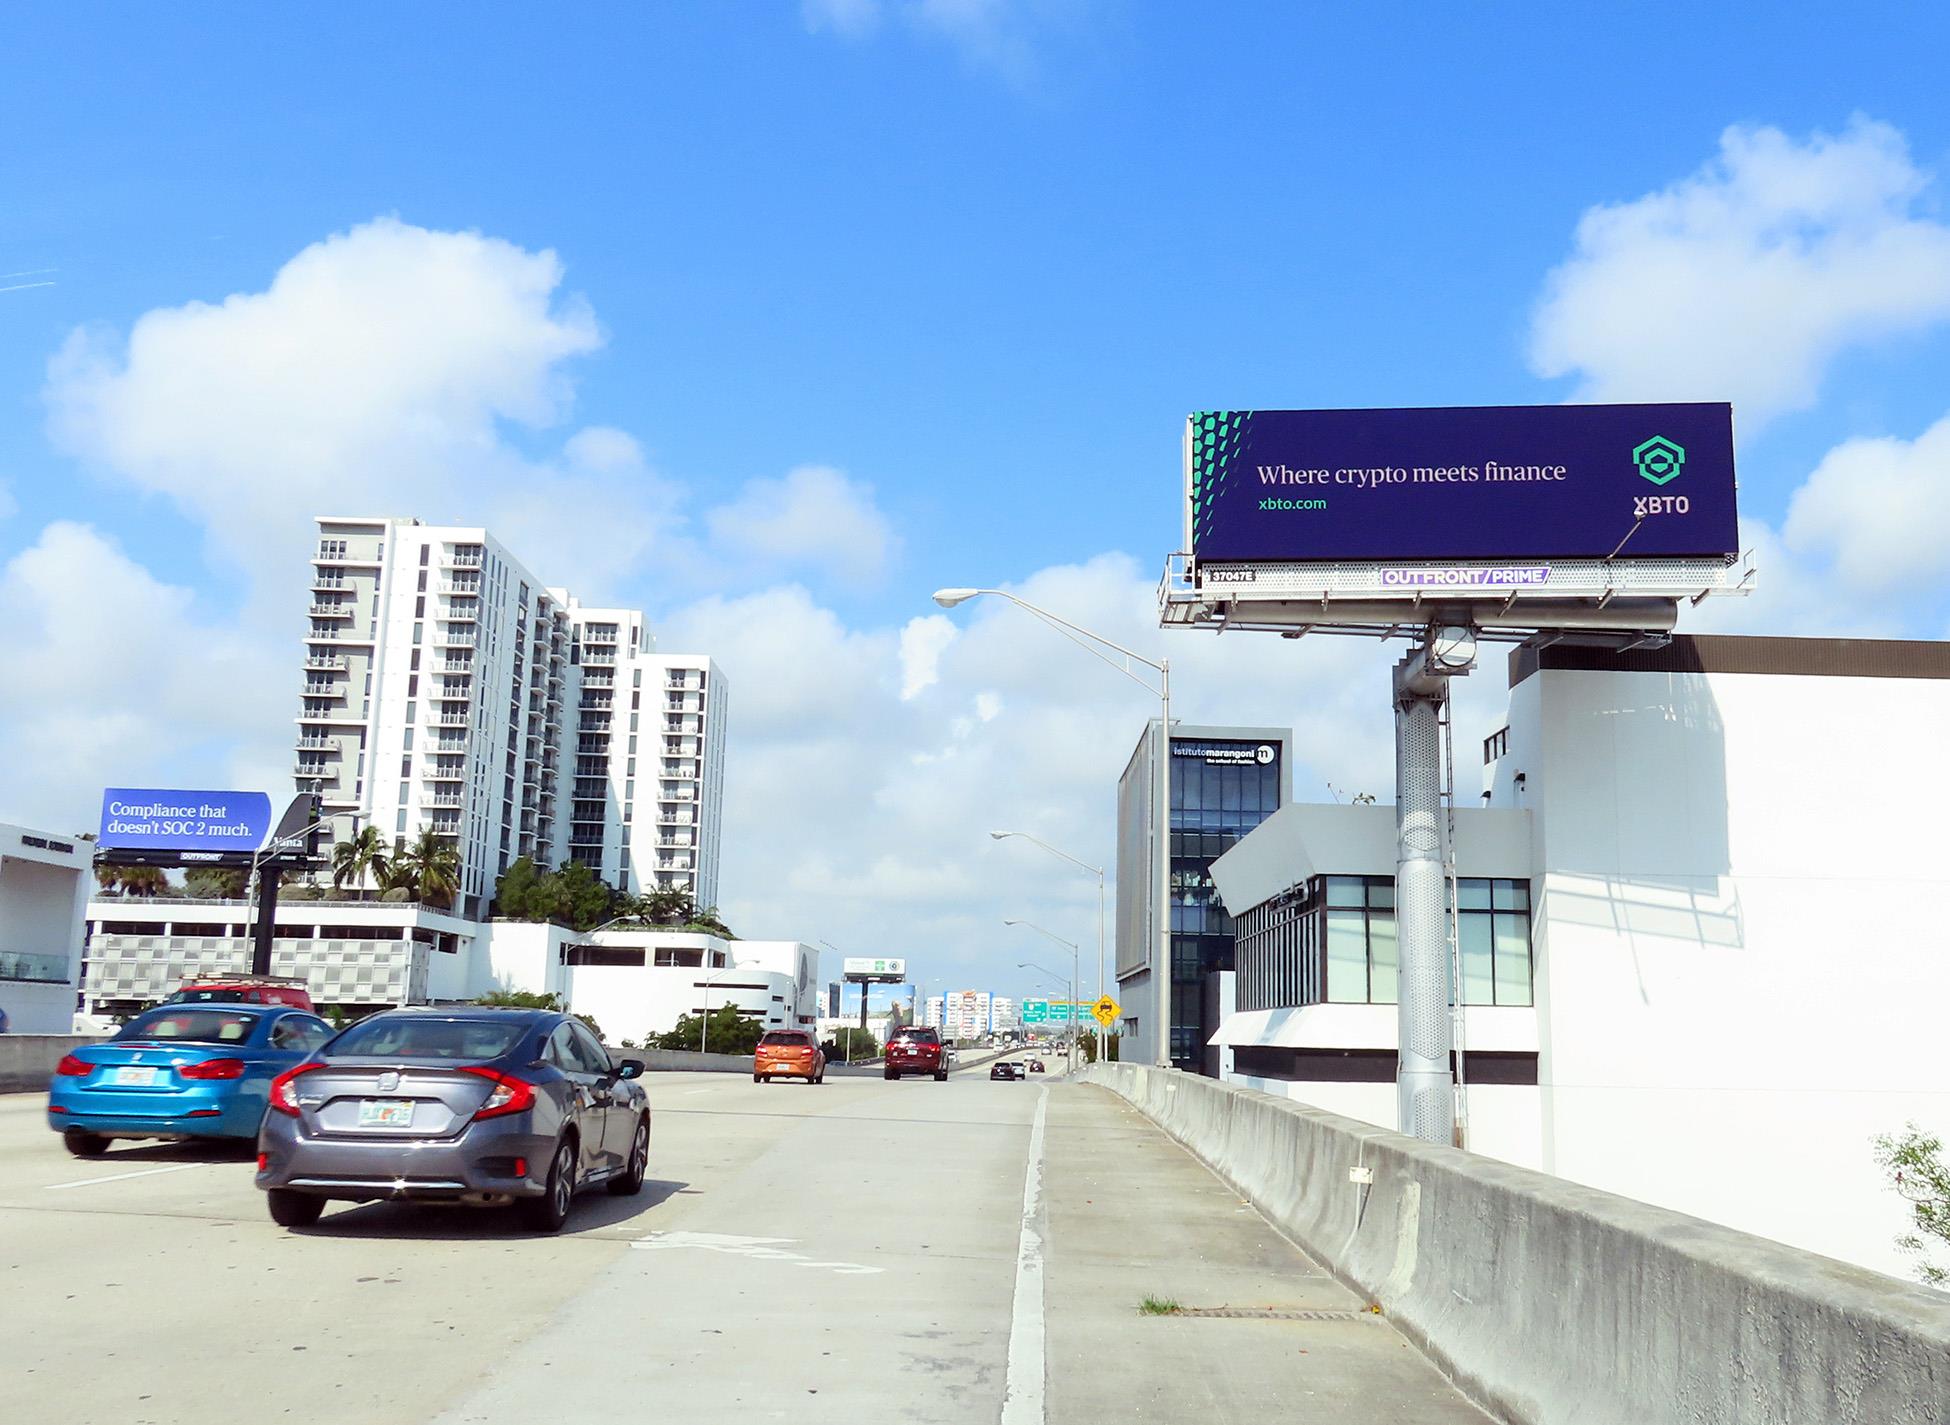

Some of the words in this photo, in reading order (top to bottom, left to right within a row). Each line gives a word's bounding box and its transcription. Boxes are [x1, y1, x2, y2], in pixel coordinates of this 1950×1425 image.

[1257, 465, 1329, 485] Where
[1335, 466, 1407, 488] crypto
[1412, 464, 1479, 483] meets
[1484, 461, 1567, 482] finance
[1258, 497, 1327, 510] xbto.com
[1633, 496, 1689, 514] XBTO
[1212, 571, 1253, 581] 37047E
[109, 801, 196, 819] Compliance
[199, 804, 226, 818] that
[107, 820, 159, 835] doesn't
[161, 821, 194, 836] SOC
[195, 822, 205, 836] 2
[208, 822, 252, 837] much.
